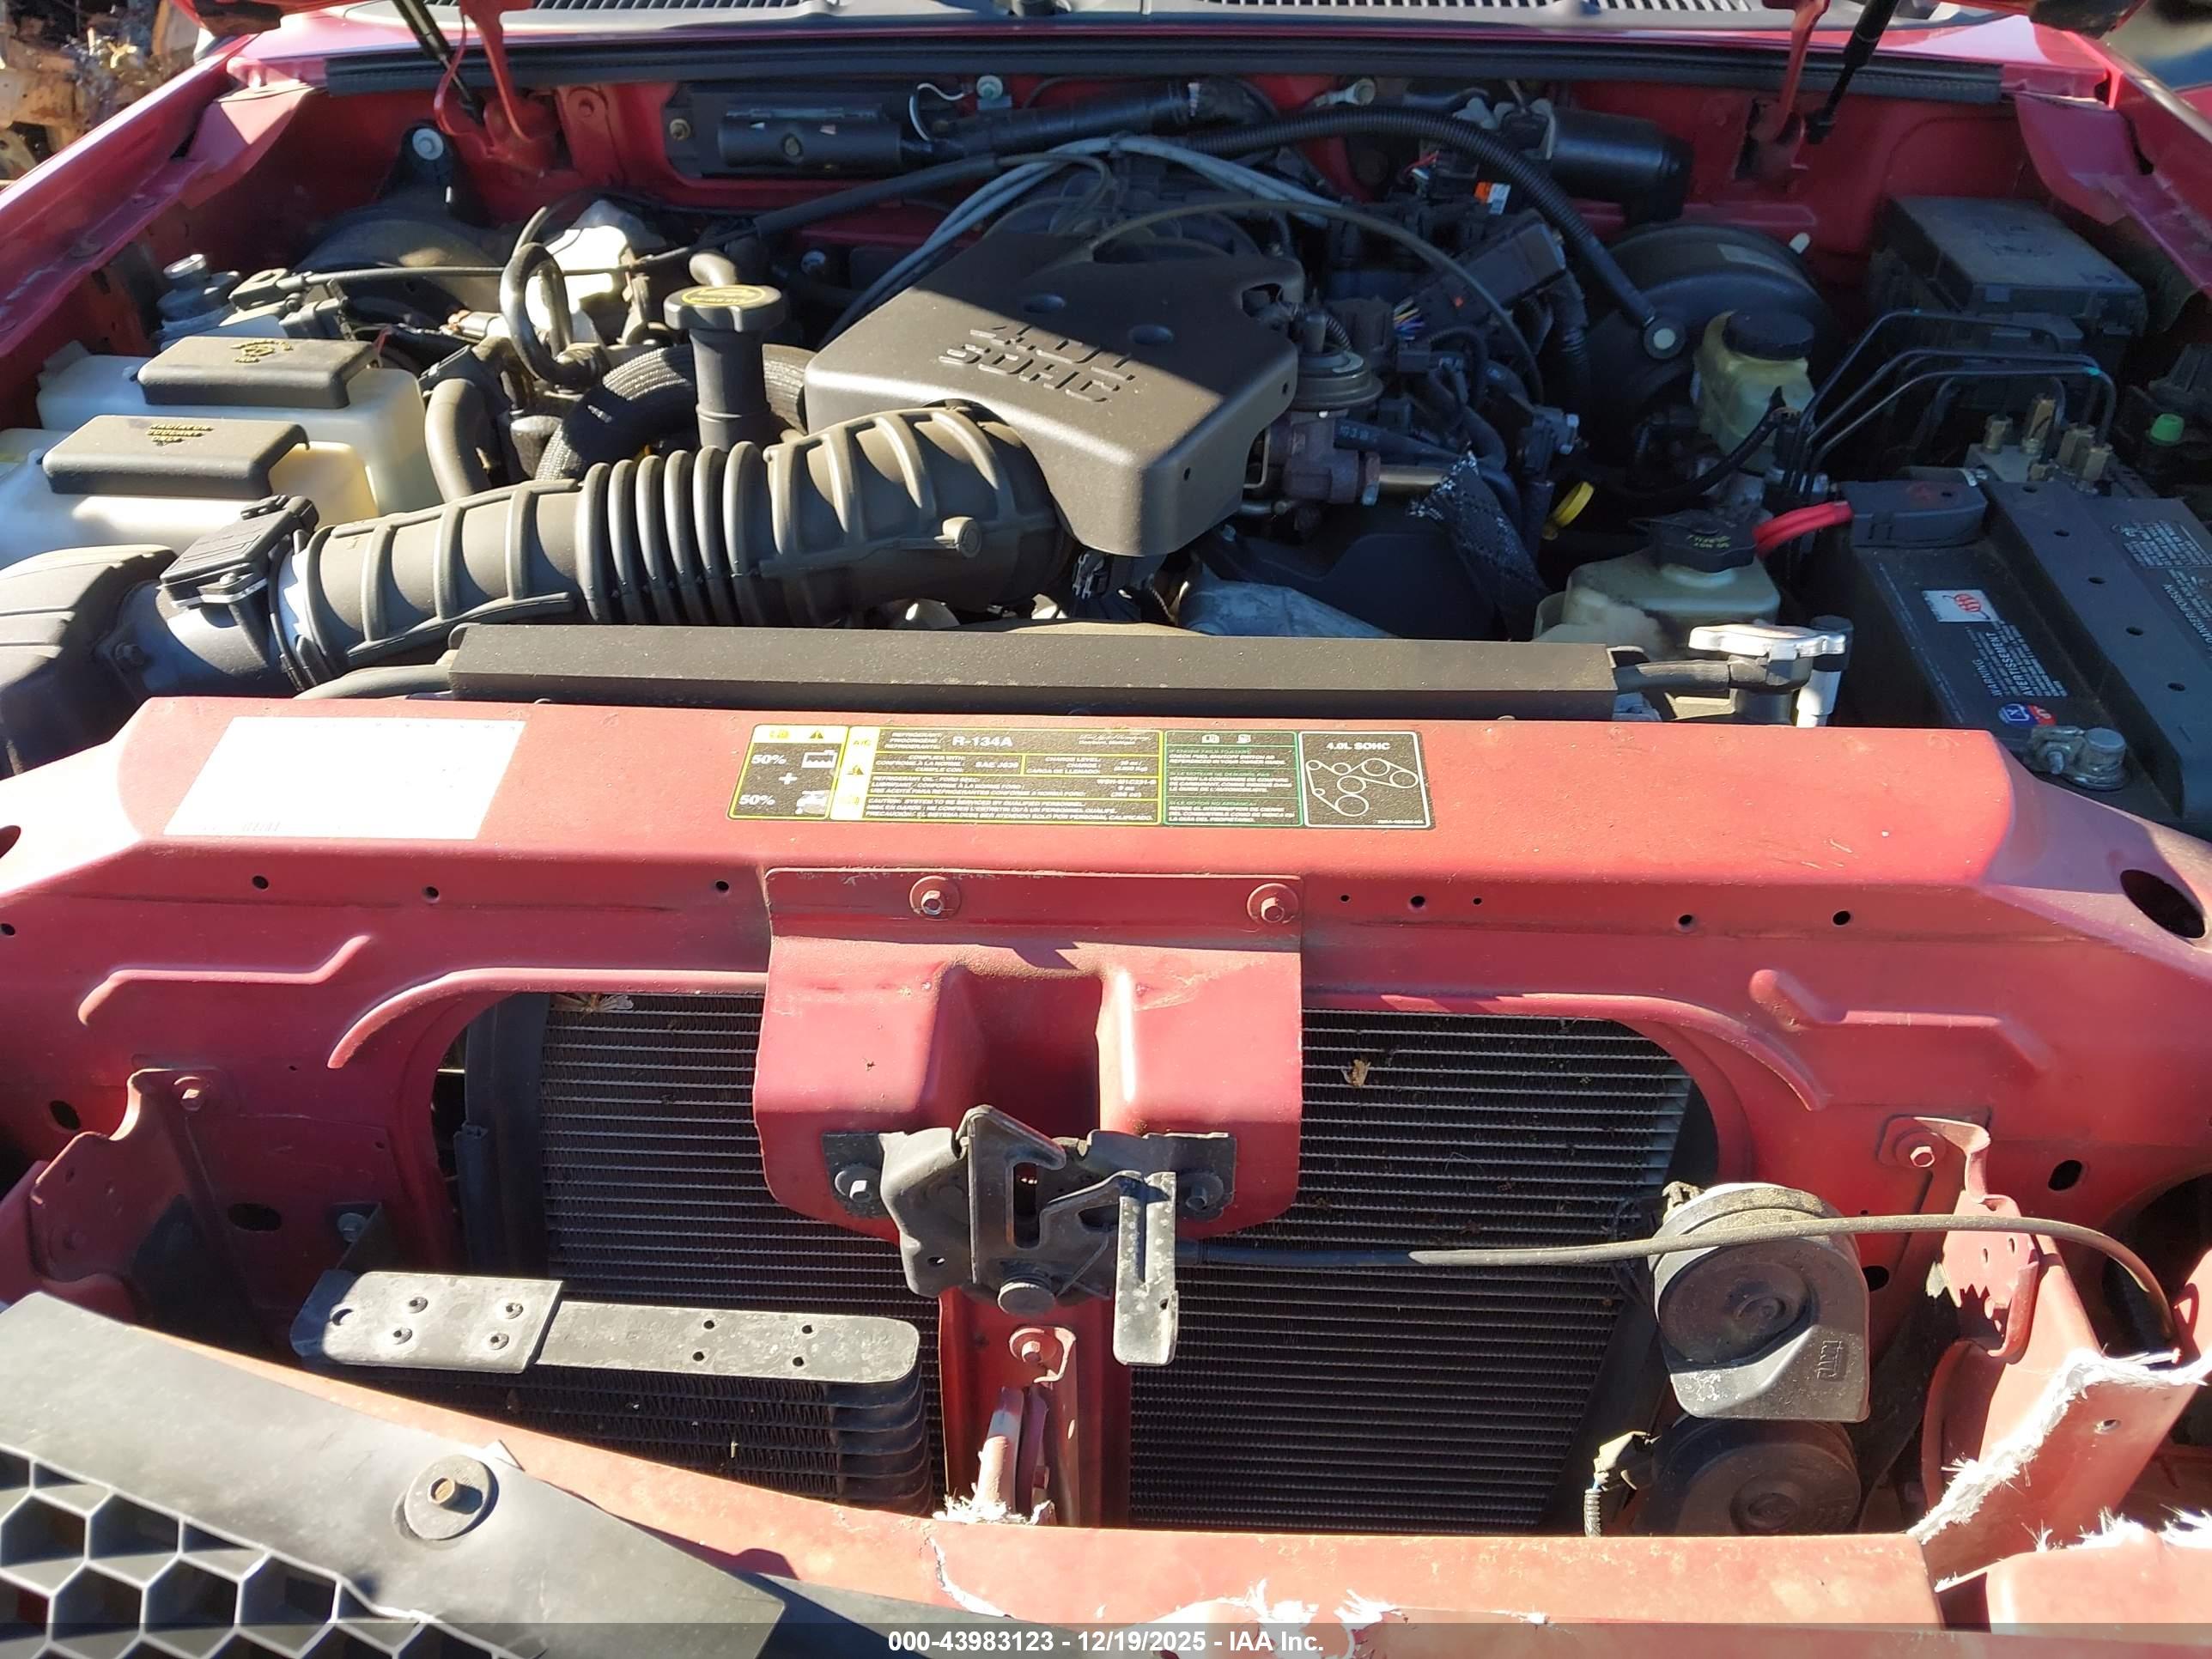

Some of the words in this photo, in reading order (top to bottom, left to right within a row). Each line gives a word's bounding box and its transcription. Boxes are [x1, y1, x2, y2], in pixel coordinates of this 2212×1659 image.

[939, 343, 1121, 403] SOHC
[1984, 631, 2035, 696] AVERTISSEMENT
[1972, 659, 2005, 697] WARNING
[951, 735, 1013, 747] R-134A
[1353, 742, 1391, 750] SOHC
[751, 754, 787, 764] 50%
[738, 794, 776, 805] 50%
